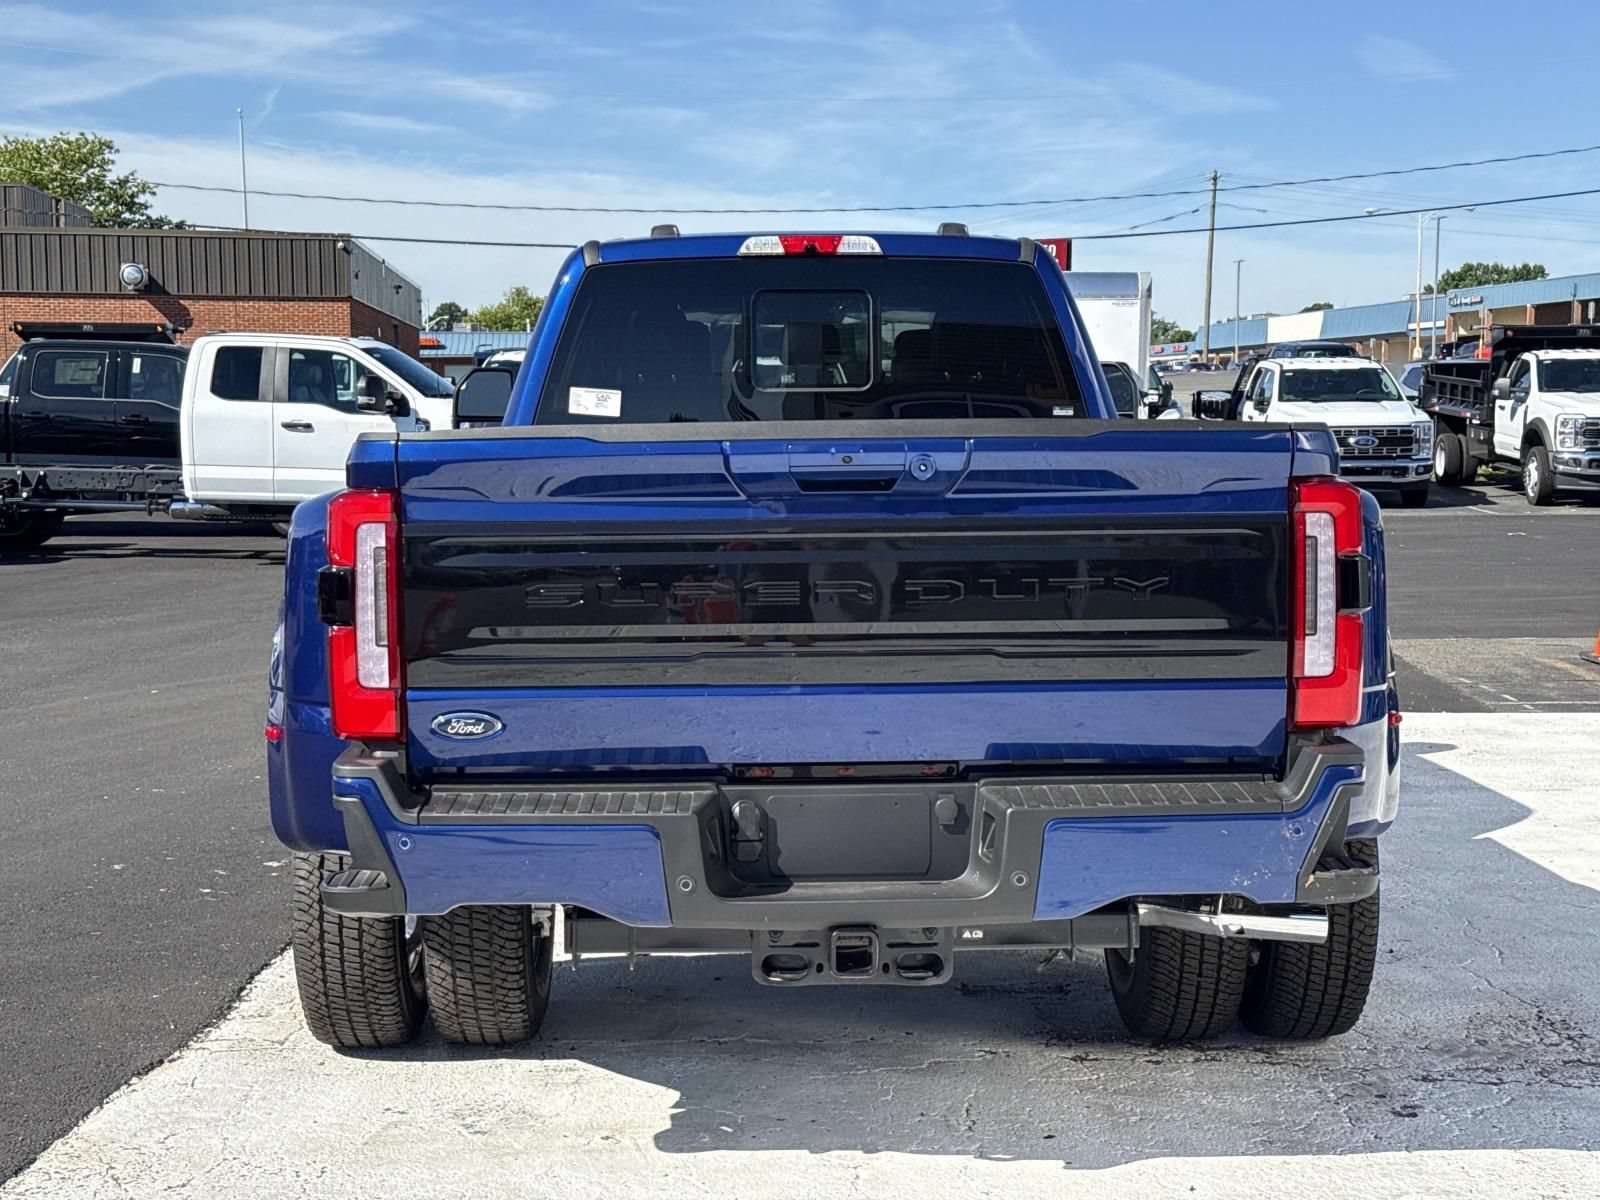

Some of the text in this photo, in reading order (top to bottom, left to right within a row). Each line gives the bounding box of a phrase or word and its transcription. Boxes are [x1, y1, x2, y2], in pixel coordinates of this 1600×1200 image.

[525, 576, 1170, 608] SUPER DUTY
[447, 718, 486, 734] Ford
